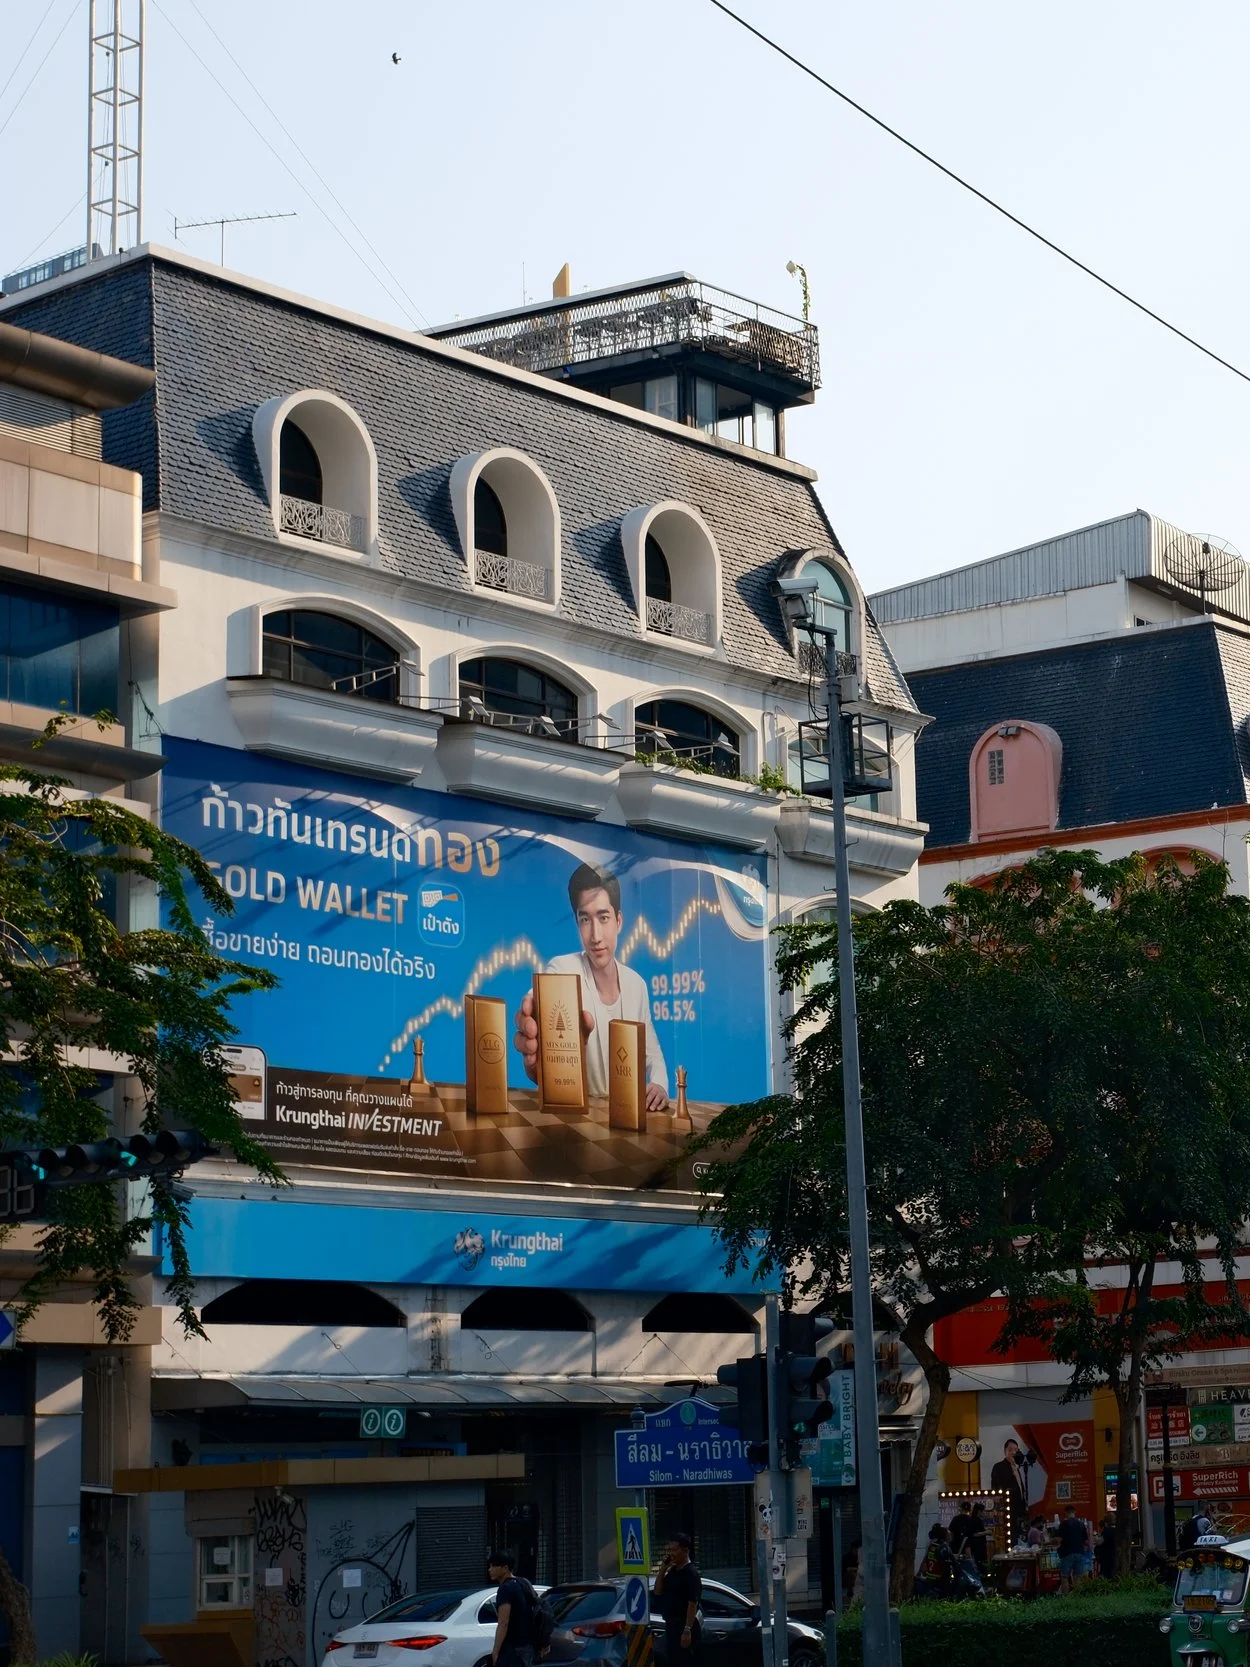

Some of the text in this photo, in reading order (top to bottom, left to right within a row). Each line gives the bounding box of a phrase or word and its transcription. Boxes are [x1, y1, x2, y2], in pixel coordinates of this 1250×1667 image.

[297, 876, 408, 924] WALLET
[422, 913, 460, 935] เป๋าตัง
[308, 945, 435, 980] ถอนทองได้จริง
[651, 970, 705, 996] 99.99%
[653, 999, 696, 1021] 96.5%
[276, 1081, 414, 1109] ก้าวสู่การลงทุน ที่คุณวางแผนได้
[275, 1105, 442, 1137] Krungthai INVESTMENT
[491, 1229, 564, 1255] Krungthai
[490, 1252, 527, 1271] กรุงไทย
[841, 1375, 852, 1457] BABY BRIGHT
[628, 1434, 661, 1463] สีลม
[1056, 1450, 1089, 1459] SuperRich
[649, 1468, 672, 1482] Silom
[683, 1468, 733, 1480] Naradhiwas
[1192, 1470, 1239, 1482] SuperRich
